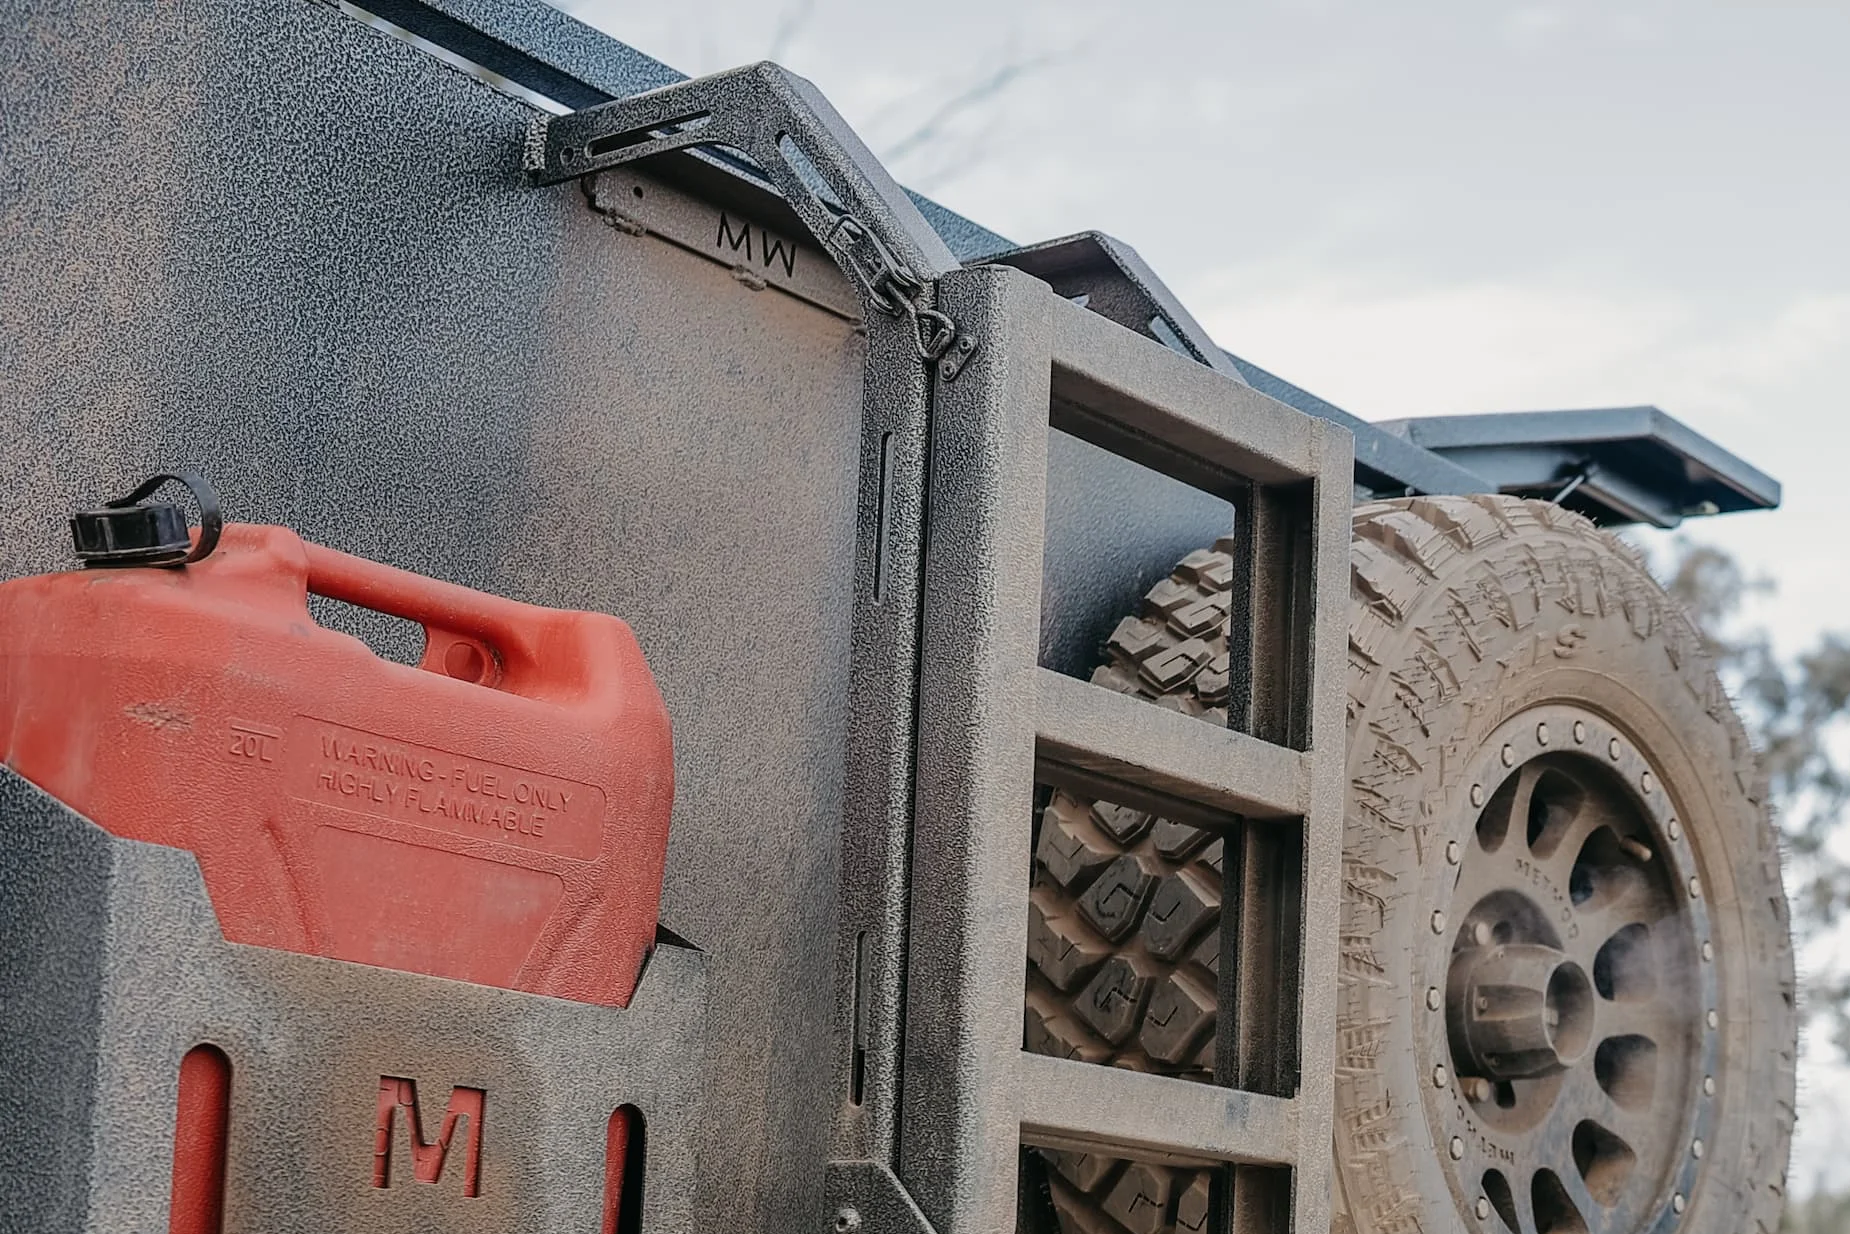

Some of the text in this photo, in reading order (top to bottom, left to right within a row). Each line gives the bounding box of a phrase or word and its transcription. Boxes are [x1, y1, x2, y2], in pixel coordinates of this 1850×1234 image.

[716, 210, 797, 279] MW
[229, 733, 273, 764] 20L
[320, 735, 435, 782] WARNING
[451, 766, 508, 800] FUEL
[513, 780, 573, 813] ONLY
[316, 767, 546, 838] HIGHLY FLAMMABLE
